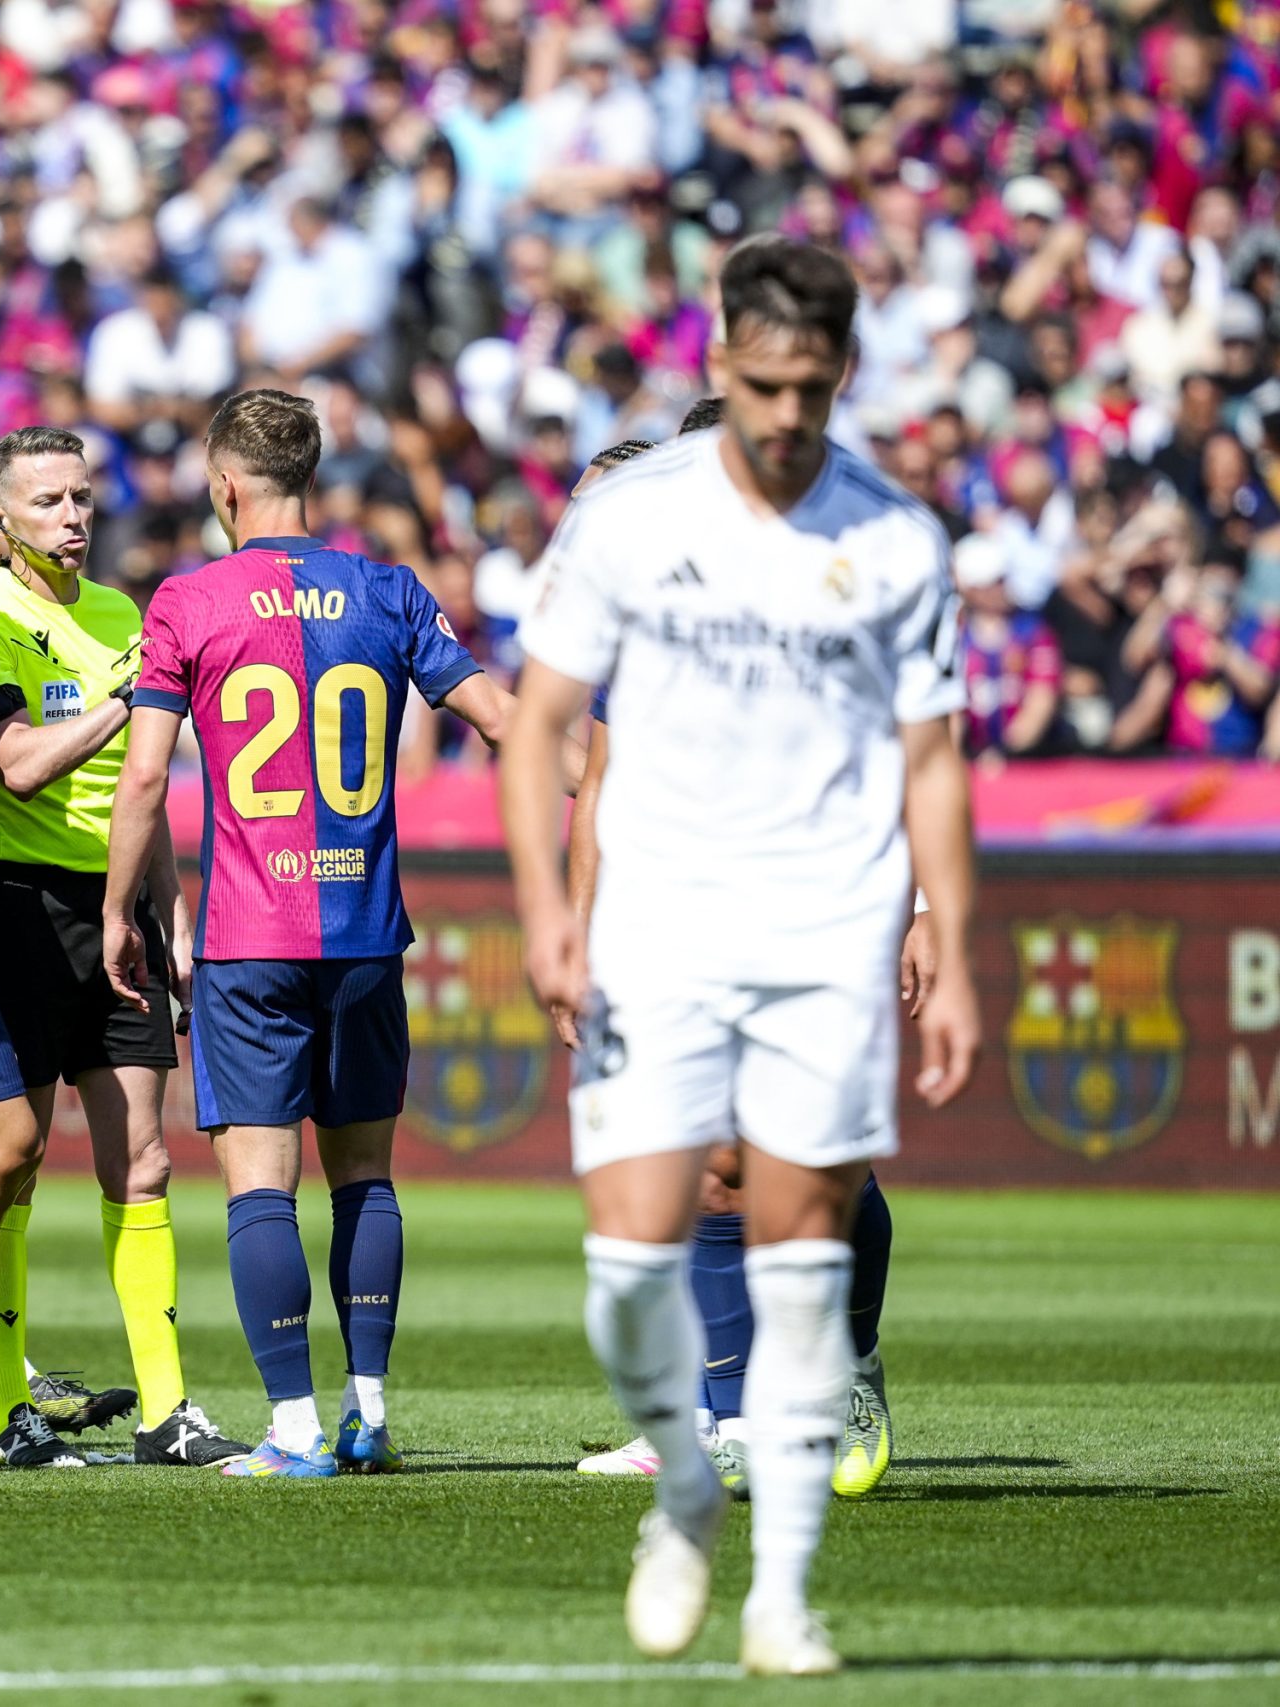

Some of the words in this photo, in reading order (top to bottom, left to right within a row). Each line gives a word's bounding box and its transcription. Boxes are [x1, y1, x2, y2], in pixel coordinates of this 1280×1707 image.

[249, 587, 346, 621] OLMO
[45, 684, 80, 701] FIFA
[45, 708, 82, 719] REFEREE
[220, 663, 388, 820] 20
[310, 848, 365, 863] UNHCR
[310, 862, 365, 876] ACNUR
